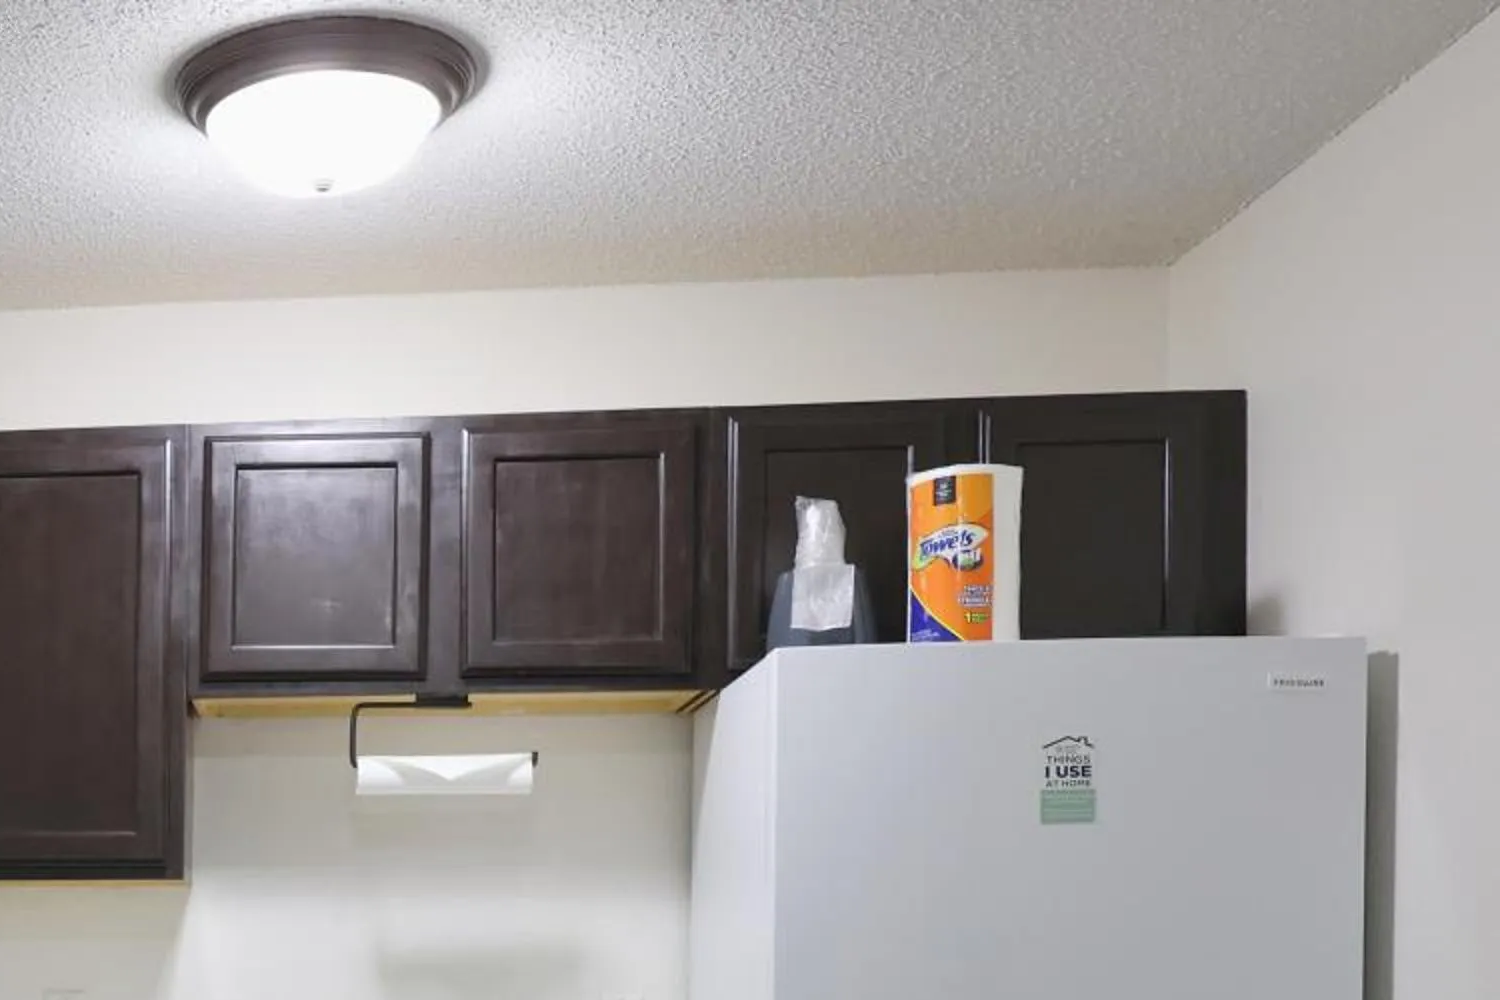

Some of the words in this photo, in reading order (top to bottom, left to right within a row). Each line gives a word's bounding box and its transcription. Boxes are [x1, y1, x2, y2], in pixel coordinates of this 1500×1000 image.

[1047, 755, 1091, 765] THINGS
[1045, 765, 1050, 779] I
[1056, 765, 1092, 778] USE
[1046, 779, 1059, 788] AT
[1062, 779, 1090, 788] HOME
